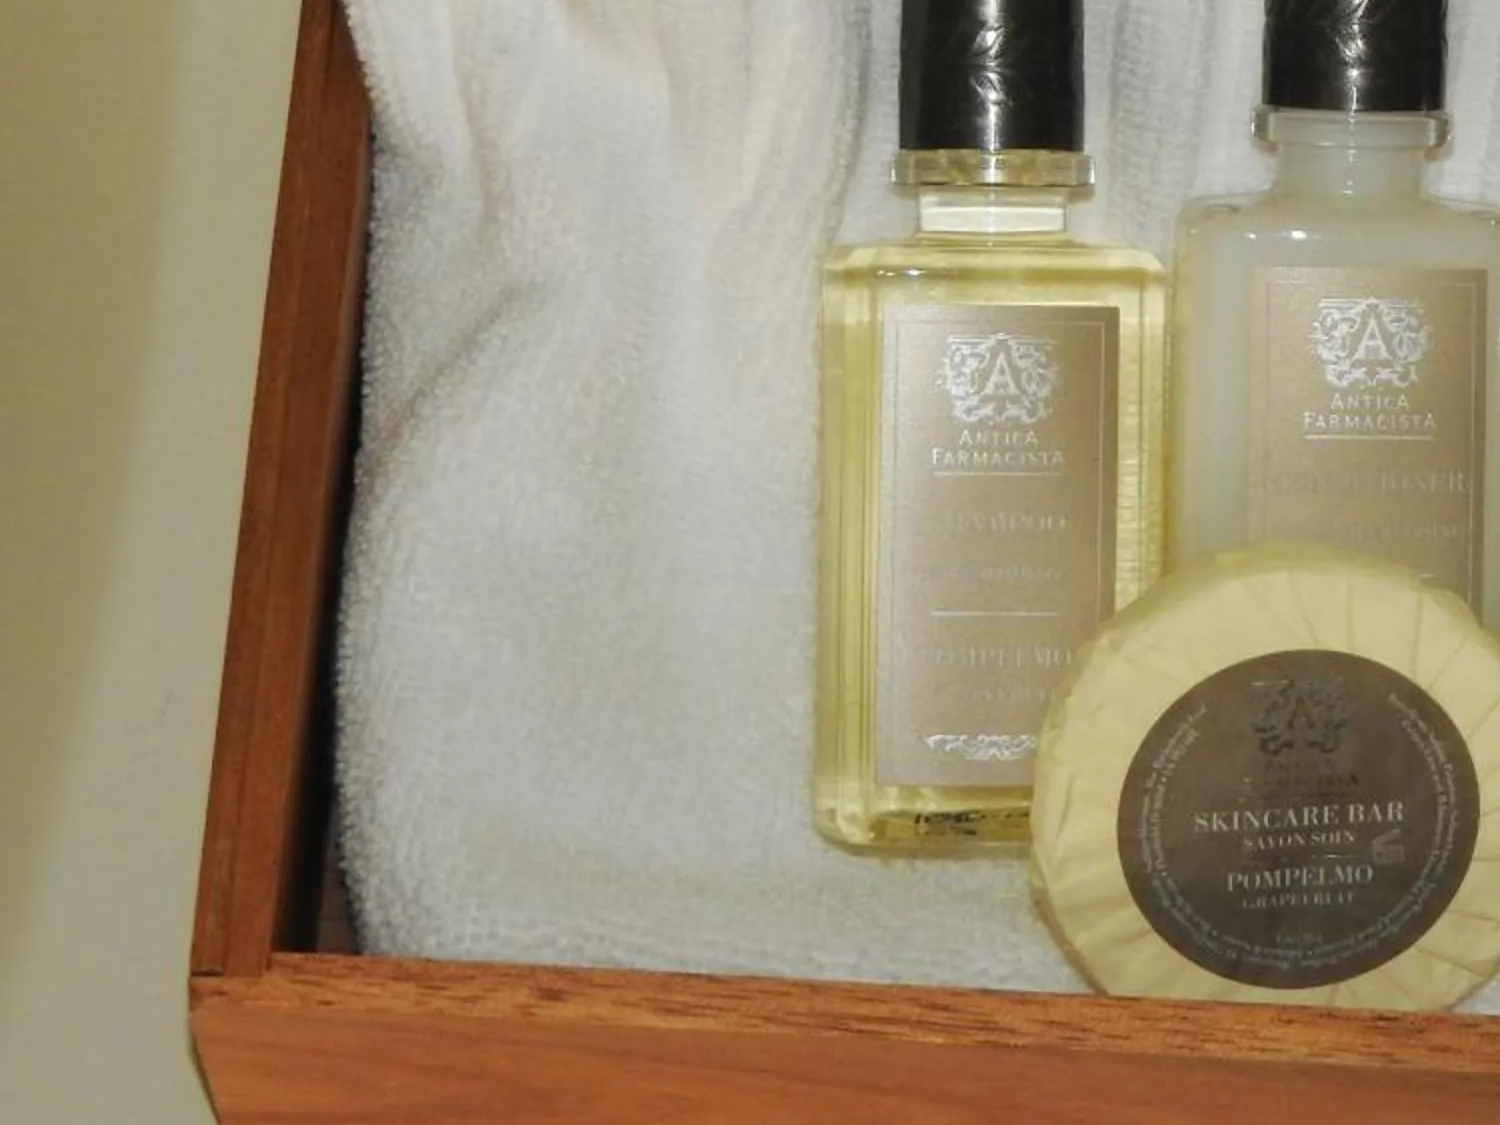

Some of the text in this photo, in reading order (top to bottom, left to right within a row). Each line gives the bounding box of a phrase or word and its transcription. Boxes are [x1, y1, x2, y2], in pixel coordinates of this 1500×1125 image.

[1330, 392, 1410, 410] ANTICA
[1302, 411, 1437, 431] FARMACISTA
[959, 428, 1039, 445] ANTICA
[931, 447, 1065, 467] FARMACISTA
[920, 645, 1073, 668] OMPELMO
[1194, 801, 1404, 832] SKINCARE BAR
[1243, 830, 1356, 853] SAVON SOIN
[1226, 863, 1374, 891] POMPELMO
